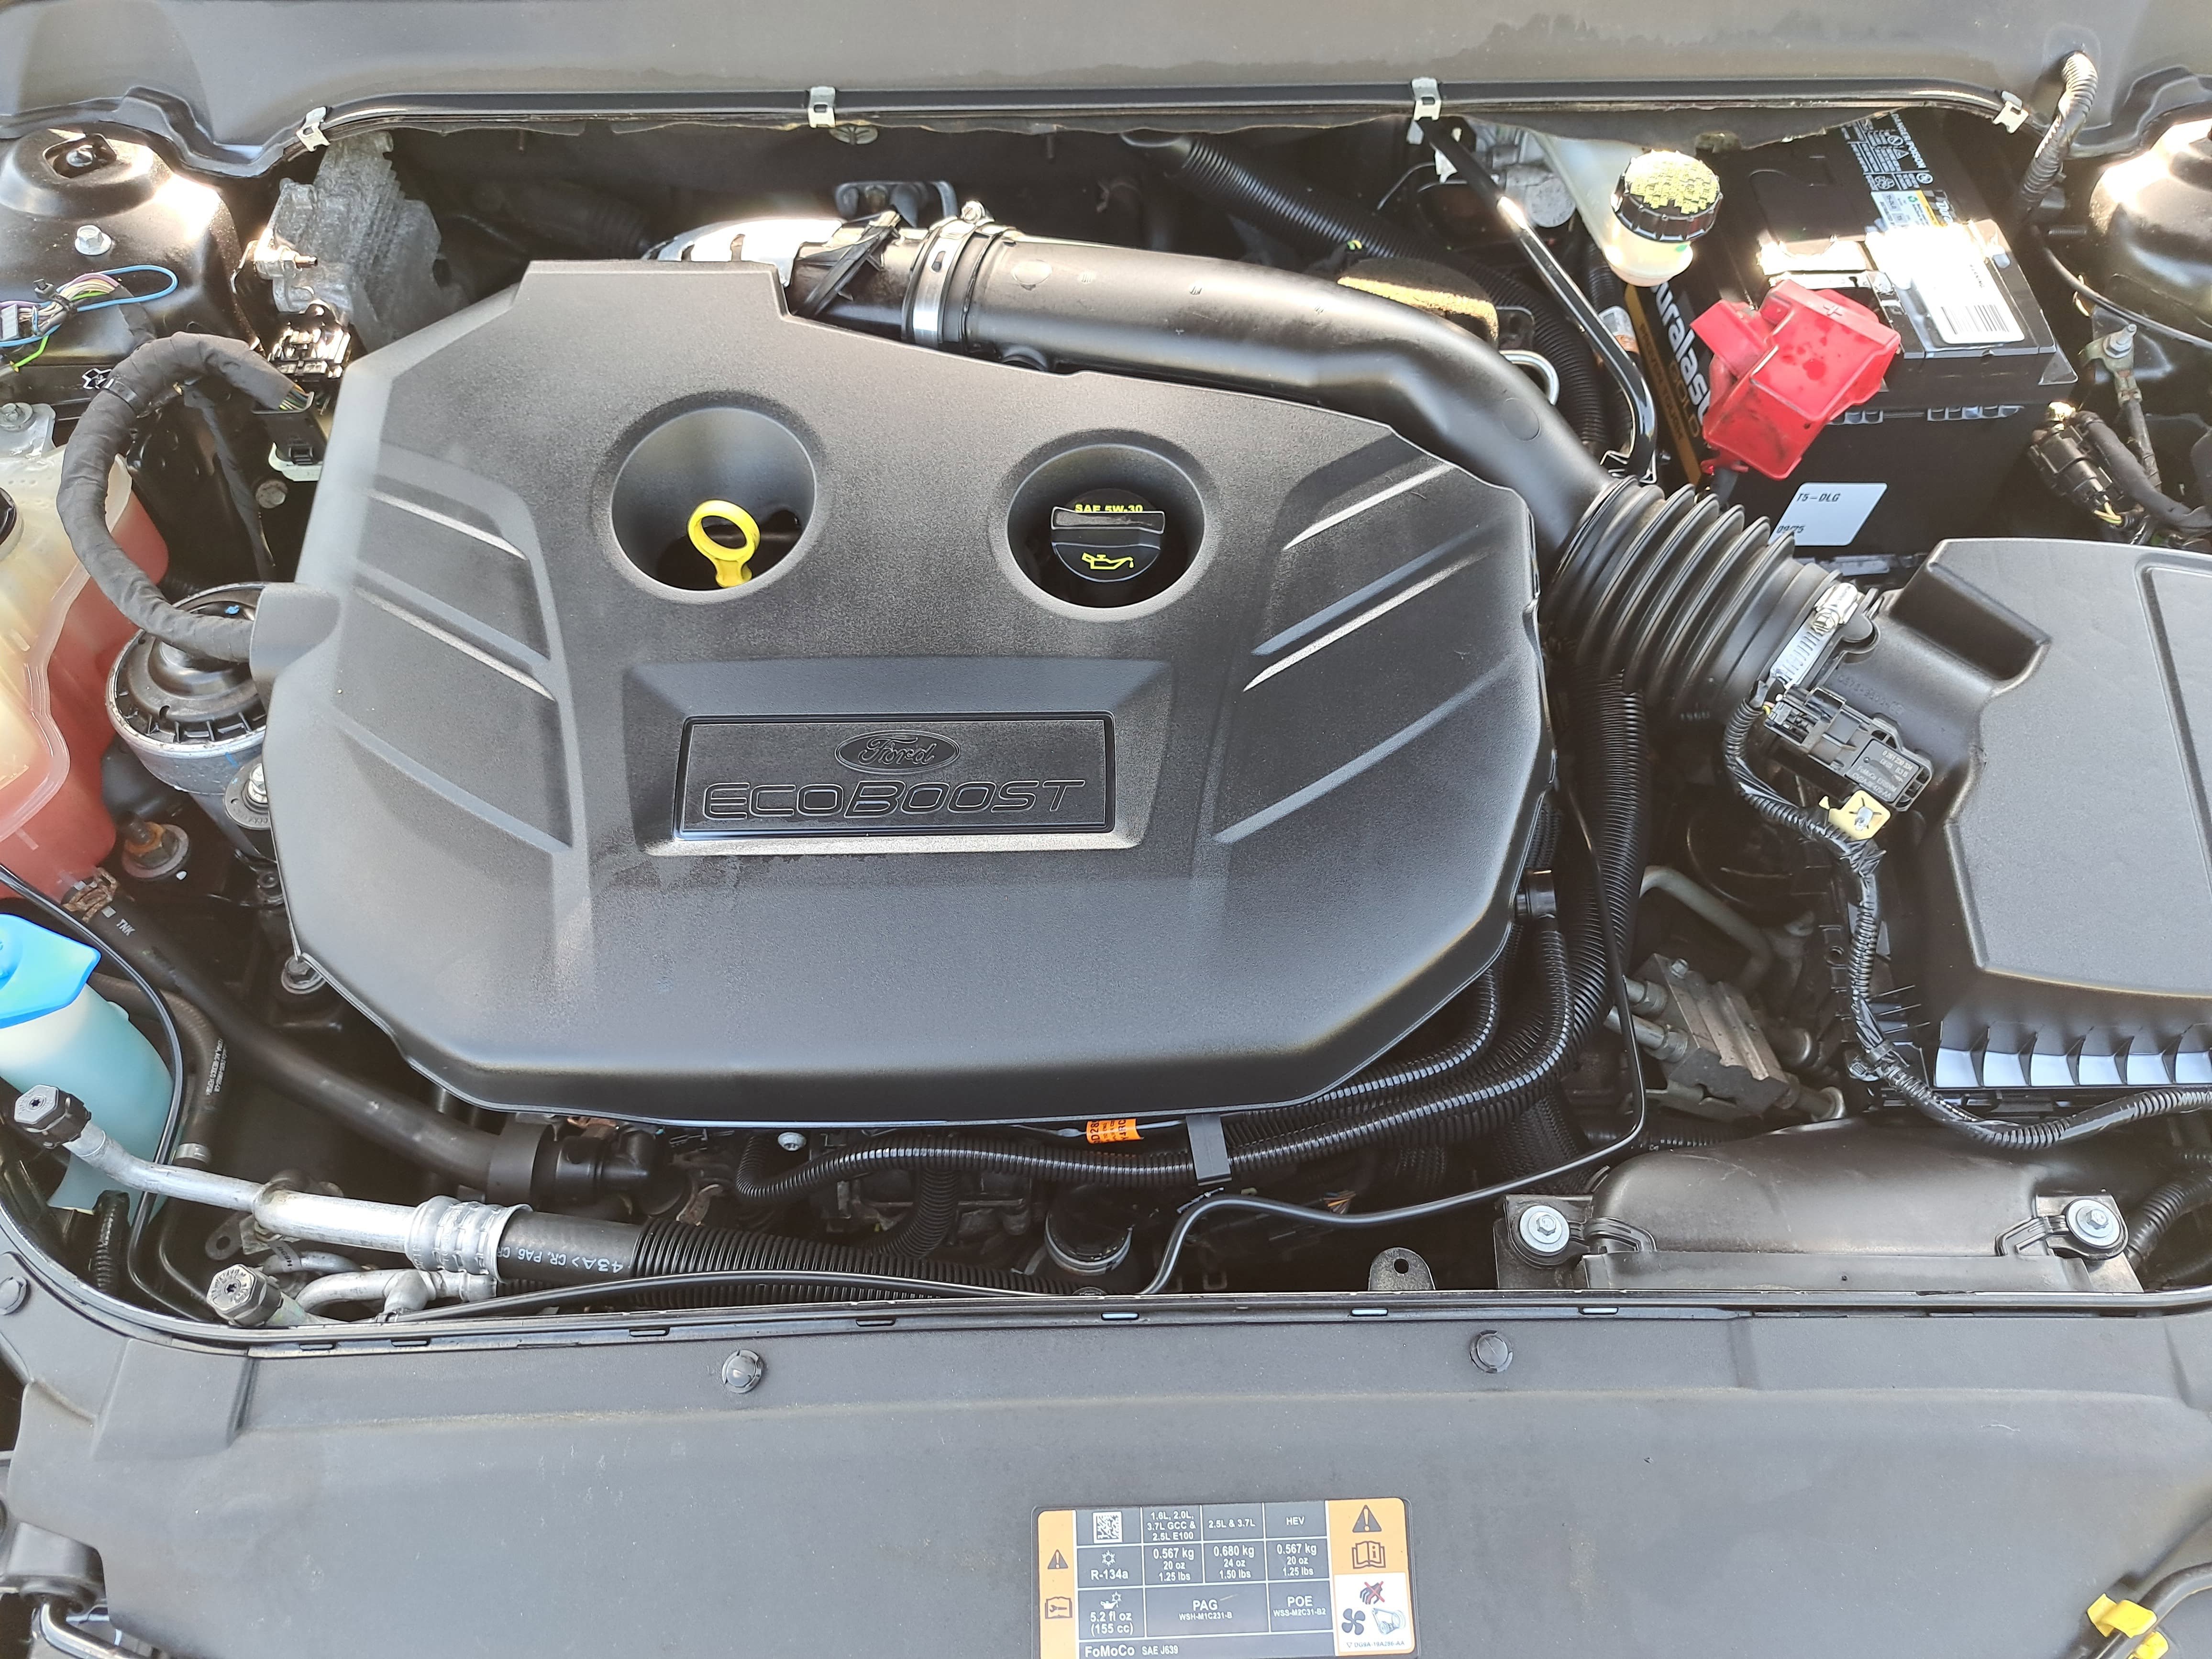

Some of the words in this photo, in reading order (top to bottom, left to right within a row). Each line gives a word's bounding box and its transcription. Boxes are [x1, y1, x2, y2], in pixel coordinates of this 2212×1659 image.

[1670, 360, 1699, 438] GOLD
[1797, 493, 1841, 502] T5-DLG
[858, 735, 936, 765] Ford
[116, 918, 135, 936] TNK
[1173, 1510, 1194, 1520] 2.0L,
[1286, 1515, 1305, 1526] HEV
[1147, 1522, 1165, 1530] 3.7L
[1167, 1521, 1186, 1530] GCC
[1189, 1521, 1196, 1529] &
[1208, 1519, 1227, 1528] 2.5L
[1228, 1519, 1235, 1528] &
[1238, 1518, 1255, 1527] 3.7L
[1152, 1533, 1171, 1541] 2.5L
[1172, 1532, 1194, 1540] E100
[1153, 1548, 1179, 1559] 0.567
[1182, 1547, 1194, 1560] kg
[1213, 1545, 1239, 1557] 0.680
[1242, 1545, 1255, 1558] kg
[1276, 1543, 1302, 1555] 0.567
[1305, 1543, 1317, 1556] kg
[1163, 1560, 1173, 1570] 20
[1175, 1561, 1185, 1570] oz
[1224, 1559, 1234, 1568] 24
[1286, 1556, 1296, 1565] 20
[1091, 1569, 1129, 1580] R-134a
[1159, 1572, 1176, 1582] 1.25
[1178, 1571, 1191, 1581] lbs
[1219, 1569, 1236, 1579] 1.50
[1238, 1569, 1251, 1579] lbs
[1283, 1567, 1299, 1576] 1.25
[1301, 1566, 1314, 1576] lbs
[1193, 1599, 1218, 1611] PAG
[1287, 1595, 1313, 1607] POE
[1090, 1612, 1106, 1622] 5.2
[1109, 1611, 1116, 1621] fl
[1119, 1612, 1132, 1621] oz
[1179, 1611, 1233, 1621] WSH-M1C231-B
[1273, 1608, 1327, 1617] WSS-M2C31-B2
[1091, 1623, 1114, 1637] (155
[1117, 1622, 1133, 1635] cc)
[1085, 1644, 1135, 1658] FoMoCo
[1141, 1646, 1158, 1655] SAE
[1161, 1645, 1178, 1655] J639
